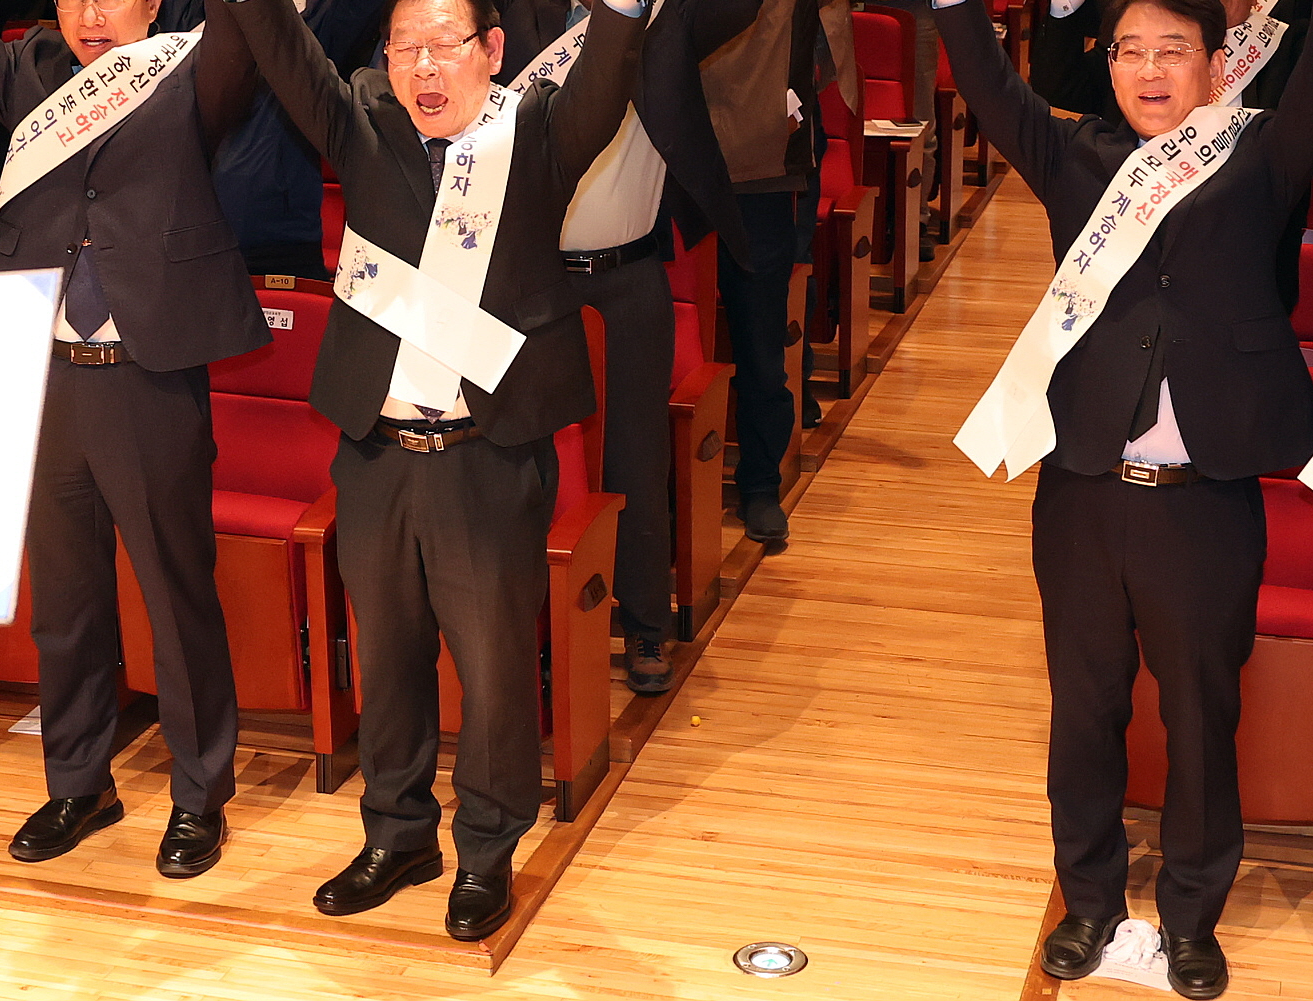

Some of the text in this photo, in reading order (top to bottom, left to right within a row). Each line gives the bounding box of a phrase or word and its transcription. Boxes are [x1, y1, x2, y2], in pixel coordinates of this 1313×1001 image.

[4, 53, 133, 165] 숭고한 뜻 이어가자
[56, 35, 189, 149] 애국정신 전승하고
[450, 136, 477, 197] 승하자
[1073, 125, 1198, 275] 우리 모두 계승하자
[1135, 107, 1252, 227] 선열들의 애국정신
[270, 277, 289, 285] A-10
